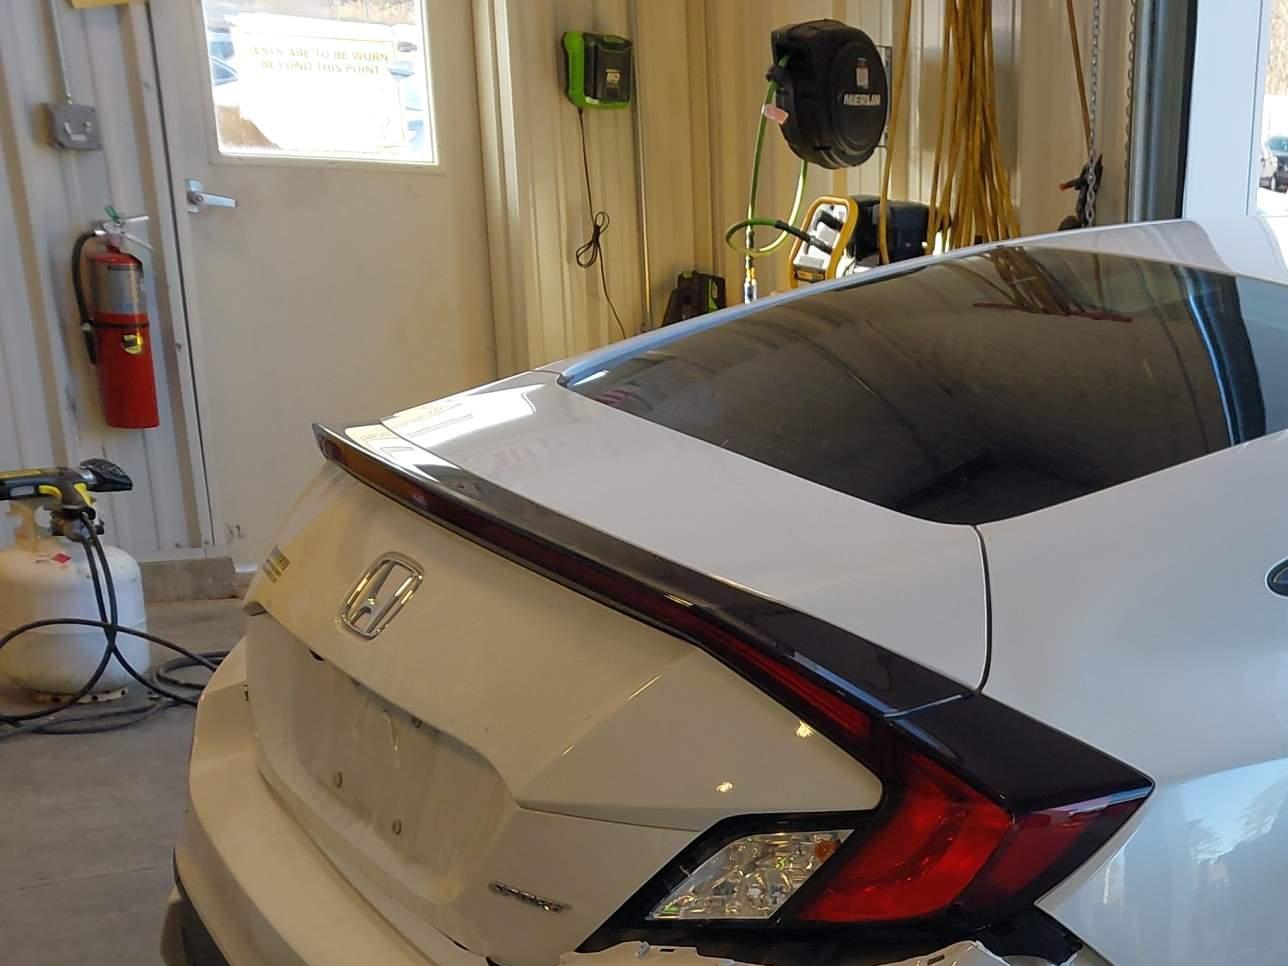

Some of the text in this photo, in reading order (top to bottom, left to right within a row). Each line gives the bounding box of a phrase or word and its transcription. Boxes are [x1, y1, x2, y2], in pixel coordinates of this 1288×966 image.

[288, 47, 310, 58] ARE
[313, 48, 330, 59] TO
[334, 49, 348, 60] BE
[352, 50, 389, 63] WORN
[261, 59, 380, 75] BEYOND THIS POINT
[843, 93, 881, 107] MERLIN
